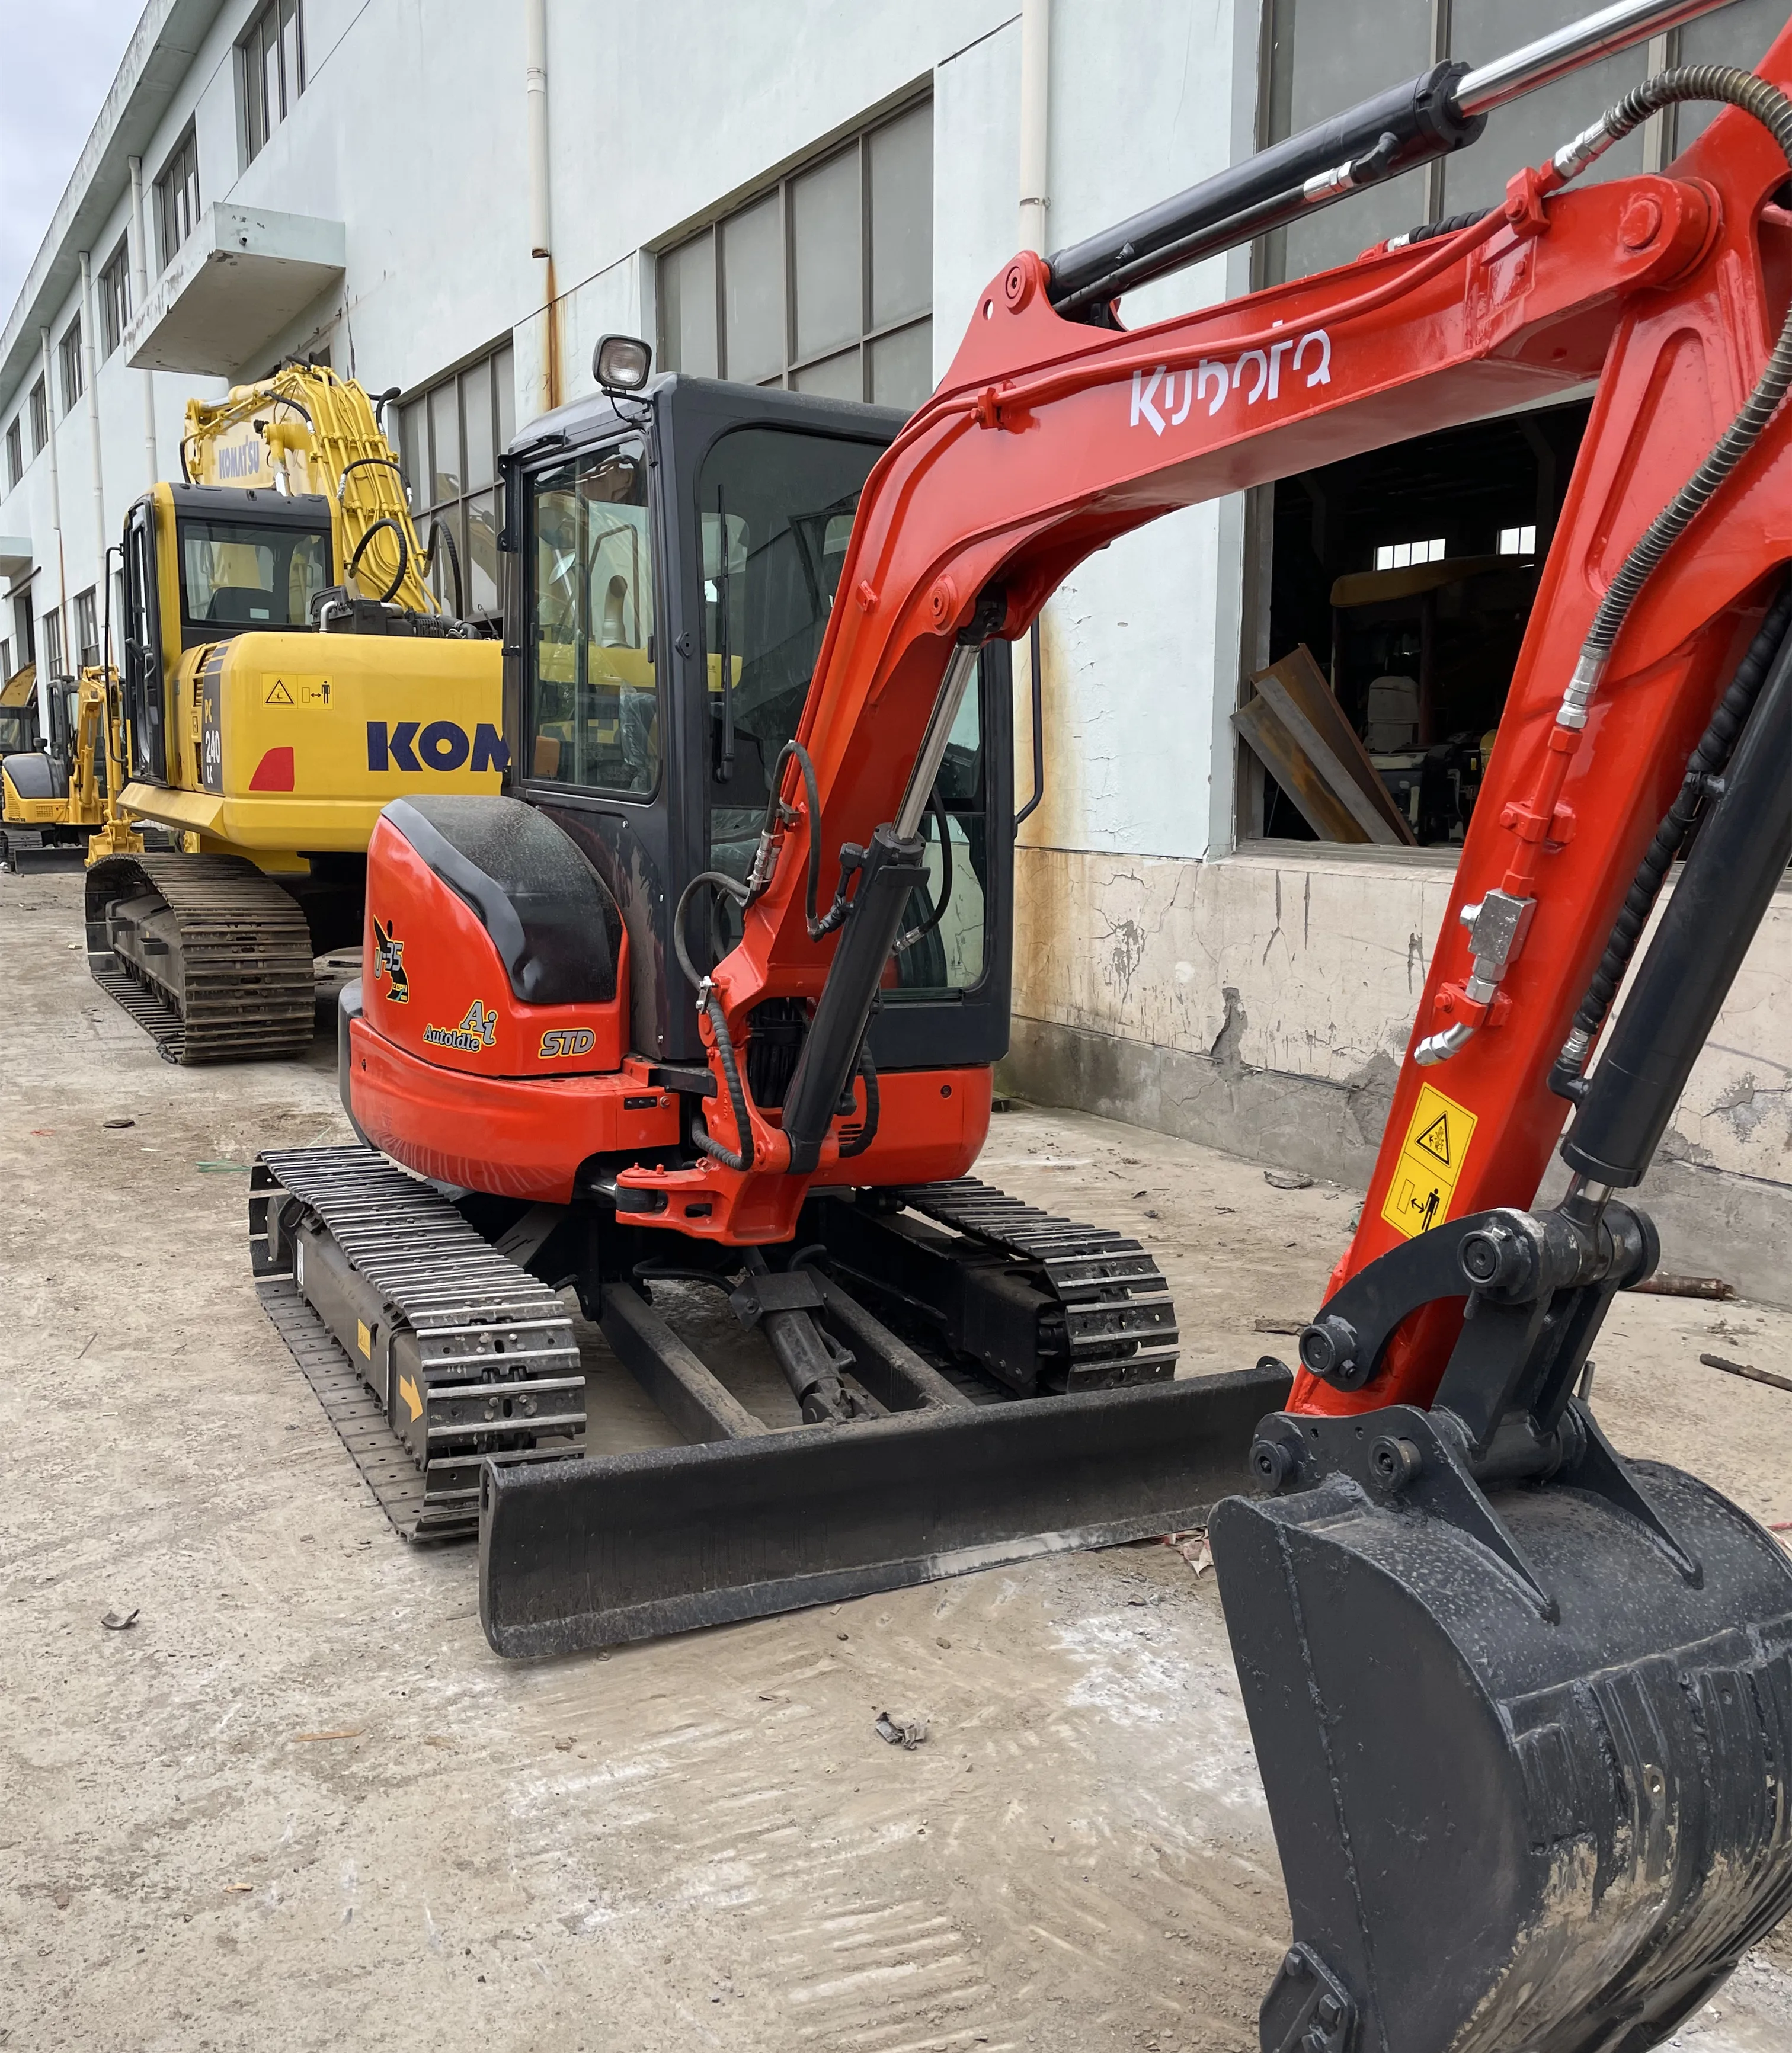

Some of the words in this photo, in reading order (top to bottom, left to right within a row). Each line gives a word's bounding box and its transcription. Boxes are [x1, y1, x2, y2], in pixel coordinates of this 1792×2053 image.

[1130, 320, 1332, 437] Kubota
[219, 434, 260, 479] KOMATSU
[204, 698, 212, 724] PC
[205, 729, 220, 763] 240
[206, 765, 213, 784] LC
[375, 941, 403, 978] U-35
[460, 1001, 497, 1045] Ai
[540, 1030, 595, 1057] STD
